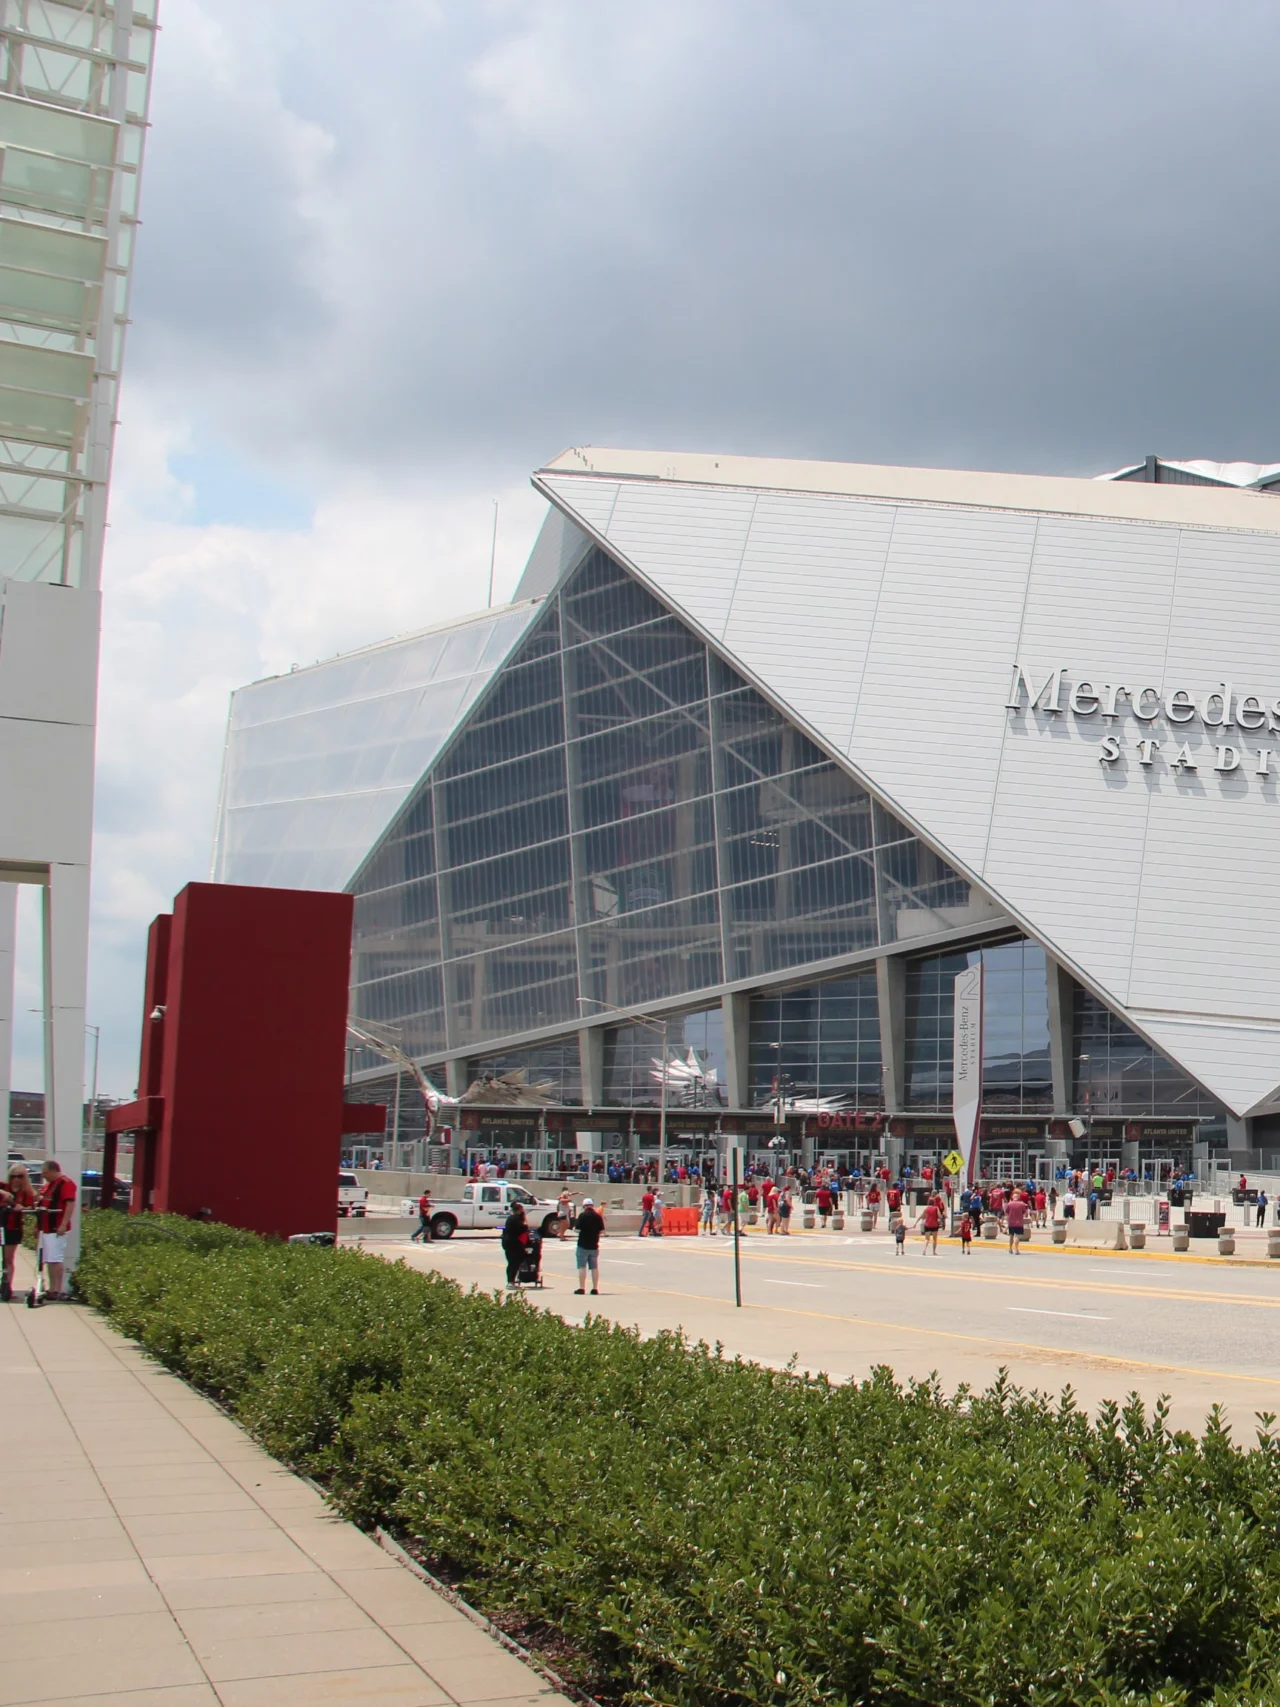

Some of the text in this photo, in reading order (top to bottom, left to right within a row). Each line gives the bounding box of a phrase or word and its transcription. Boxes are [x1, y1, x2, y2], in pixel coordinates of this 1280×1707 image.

[958, 1005, 969, 1082] Mercedes-Benz
[481, 1118, 535, 1126] ATLANTA UNITED
[818, 1112, 883, 1129] GATE 2
